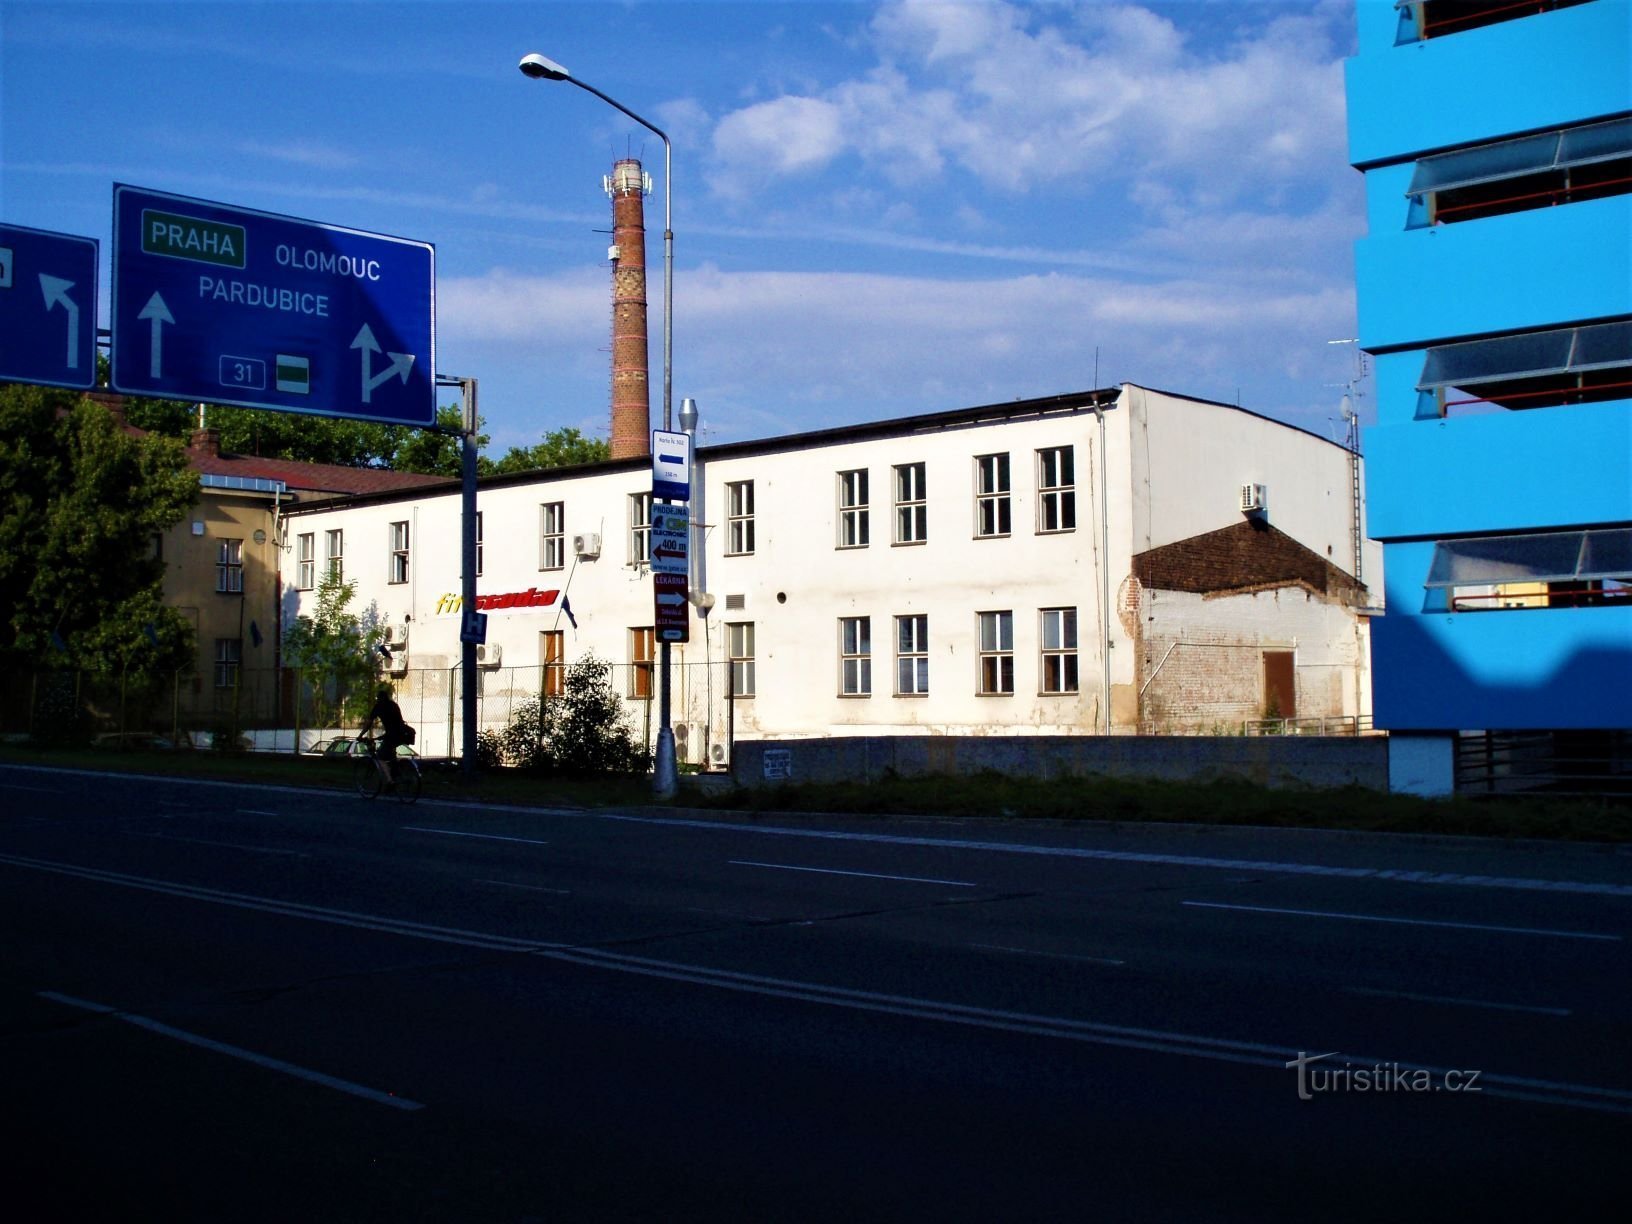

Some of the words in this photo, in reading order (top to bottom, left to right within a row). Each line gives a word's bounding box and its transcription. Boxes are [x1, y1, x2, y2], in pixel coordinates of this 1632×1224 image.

[152, 222, 235, 257] PRAHA
[276, 244, 381, 281] OLOMOUC
[199, 276, 329, 317] PARDUBICE
[234, 363, 252, 383] 31
[653, 505, 687, 516] PRODEJNA
[662, 539, 677, 550] 400
[678, 543, 687, 551] m
